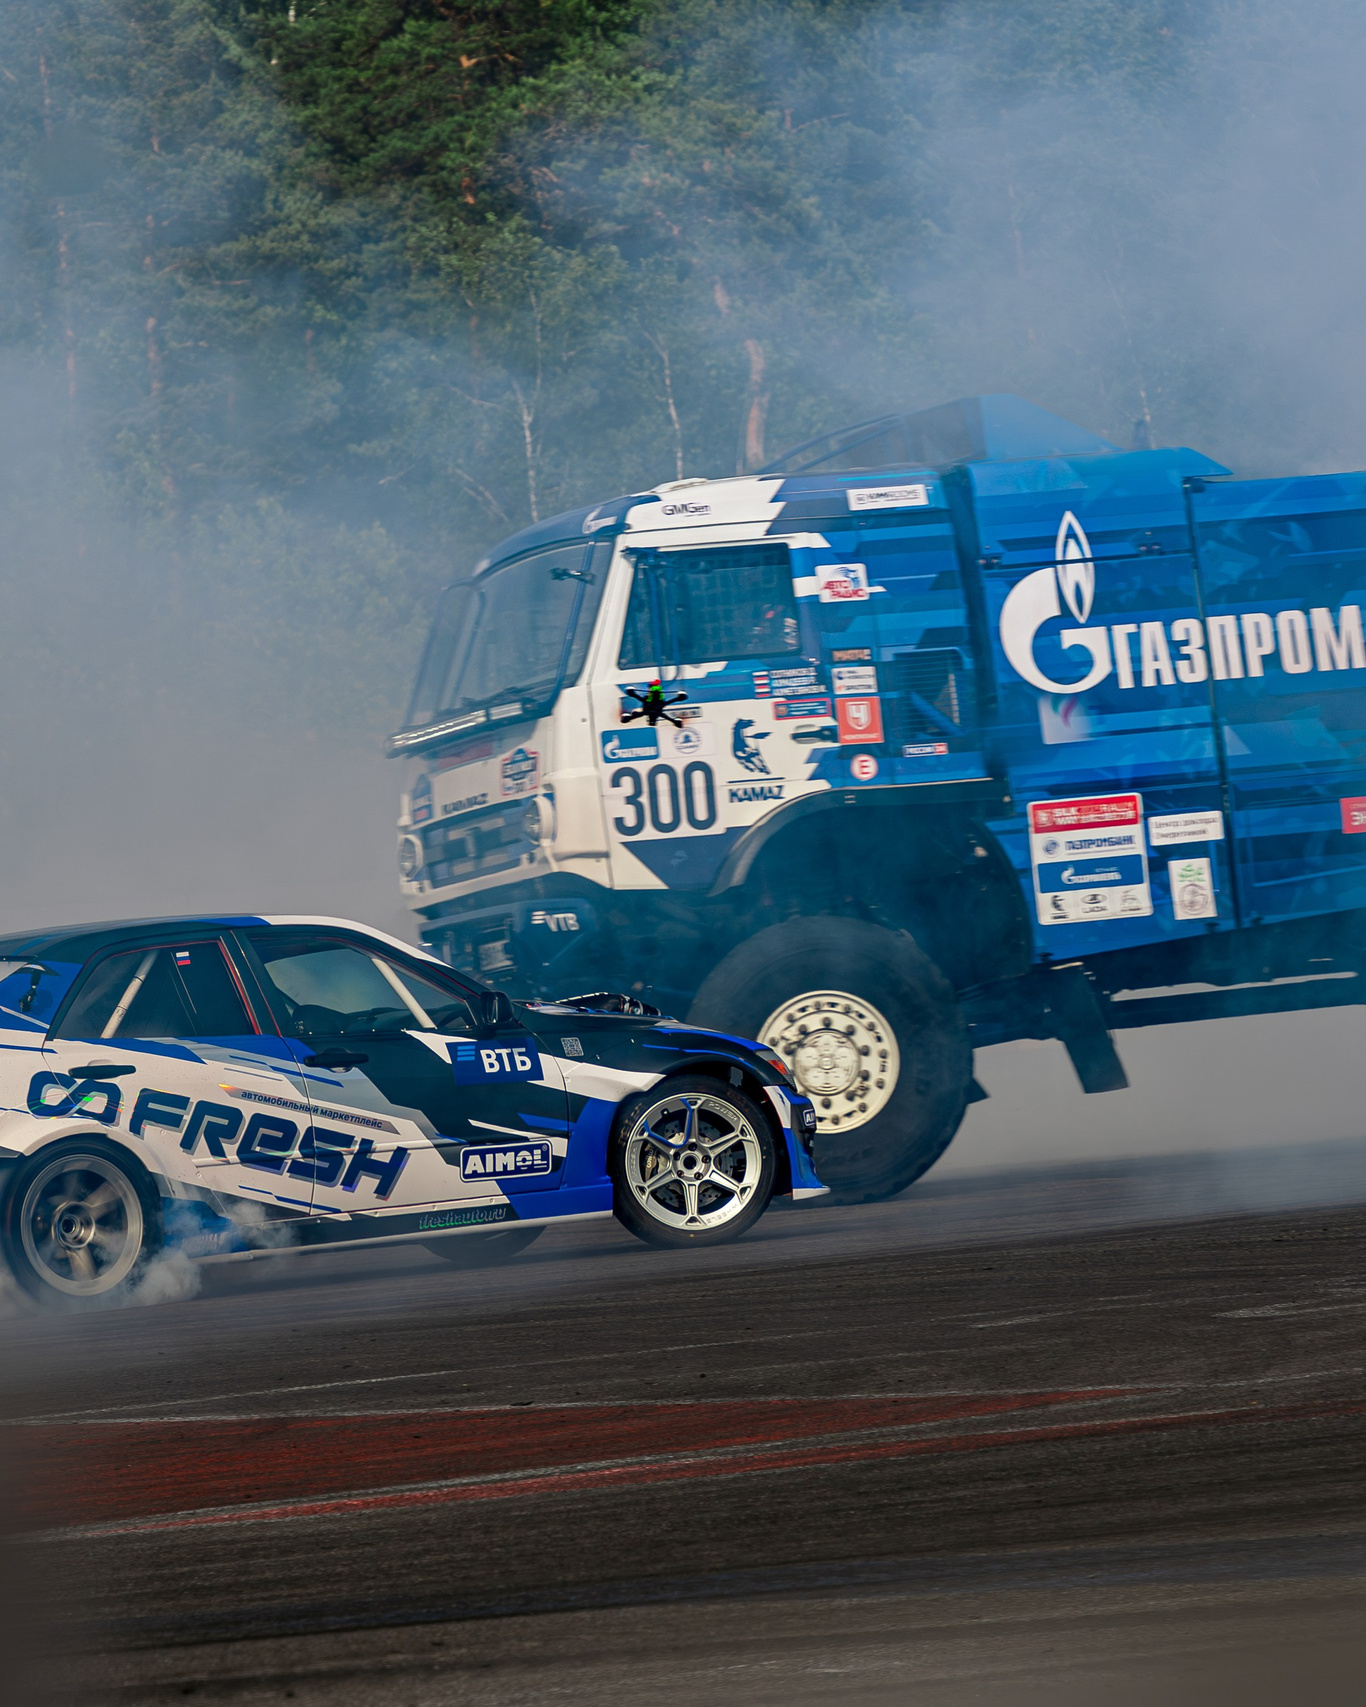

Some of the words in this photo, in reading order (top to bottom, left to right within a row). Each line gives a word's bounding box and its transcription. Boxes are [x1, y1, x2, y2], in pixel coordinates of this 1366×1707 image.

[1111, 605, 1366, 689] ГАЗПРОМ
[611, 760, 718, 836] 300
[728, 784, 786, 803] KAMAZ
[480, 1047, 532, 1074] ВТБ
[241, 1091, 319, 1114] автомобильный
[319, 1108, 383, 1129] маркетплейс
